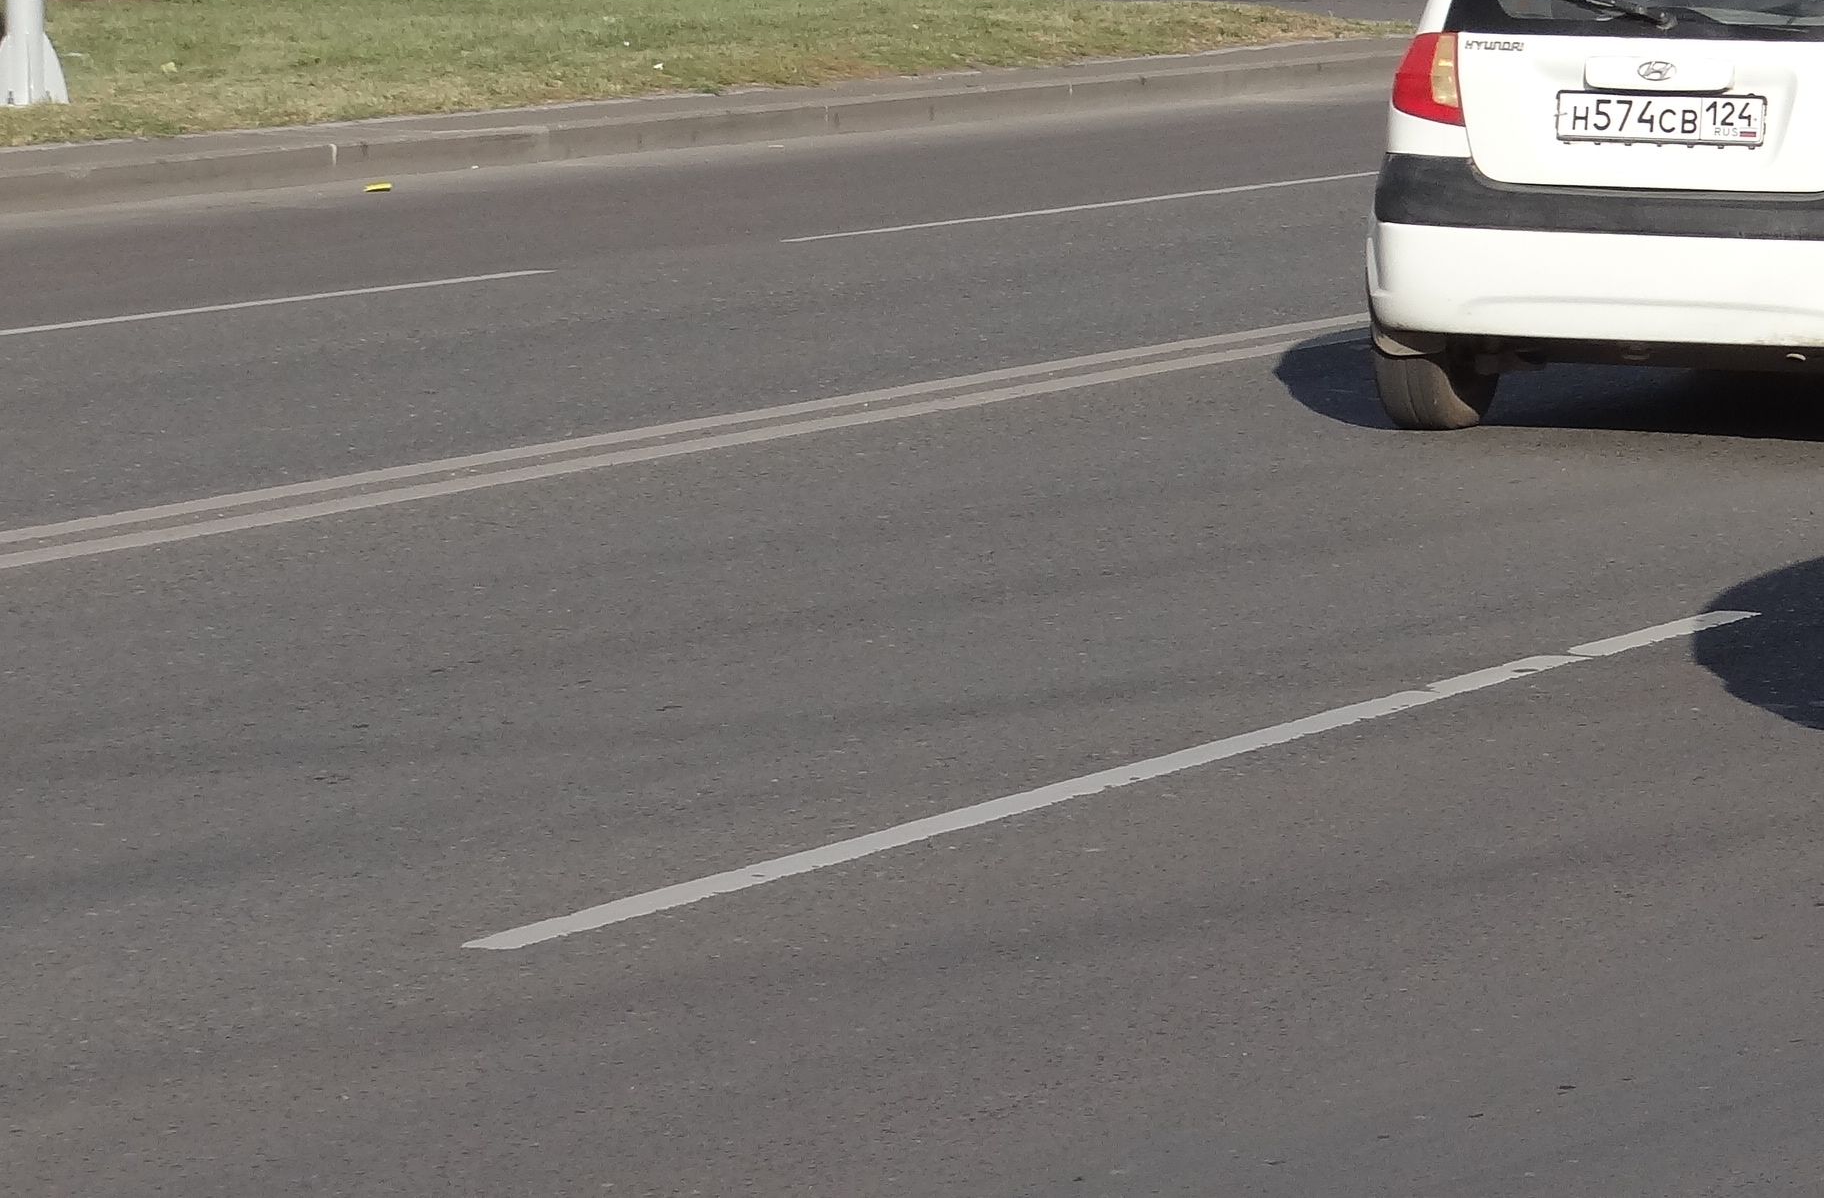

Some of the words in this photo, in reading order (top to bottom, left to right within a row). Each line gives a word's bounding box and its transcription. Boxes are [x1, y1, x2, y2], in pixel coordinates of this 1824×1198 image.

[1464, 40, 1525, 51] HYUNDAI
[1572, 99, 1698, 134] Н574СВ
[1705, 101, 1752, 127] 124
[1715, 127, 1739, 137] RUS
